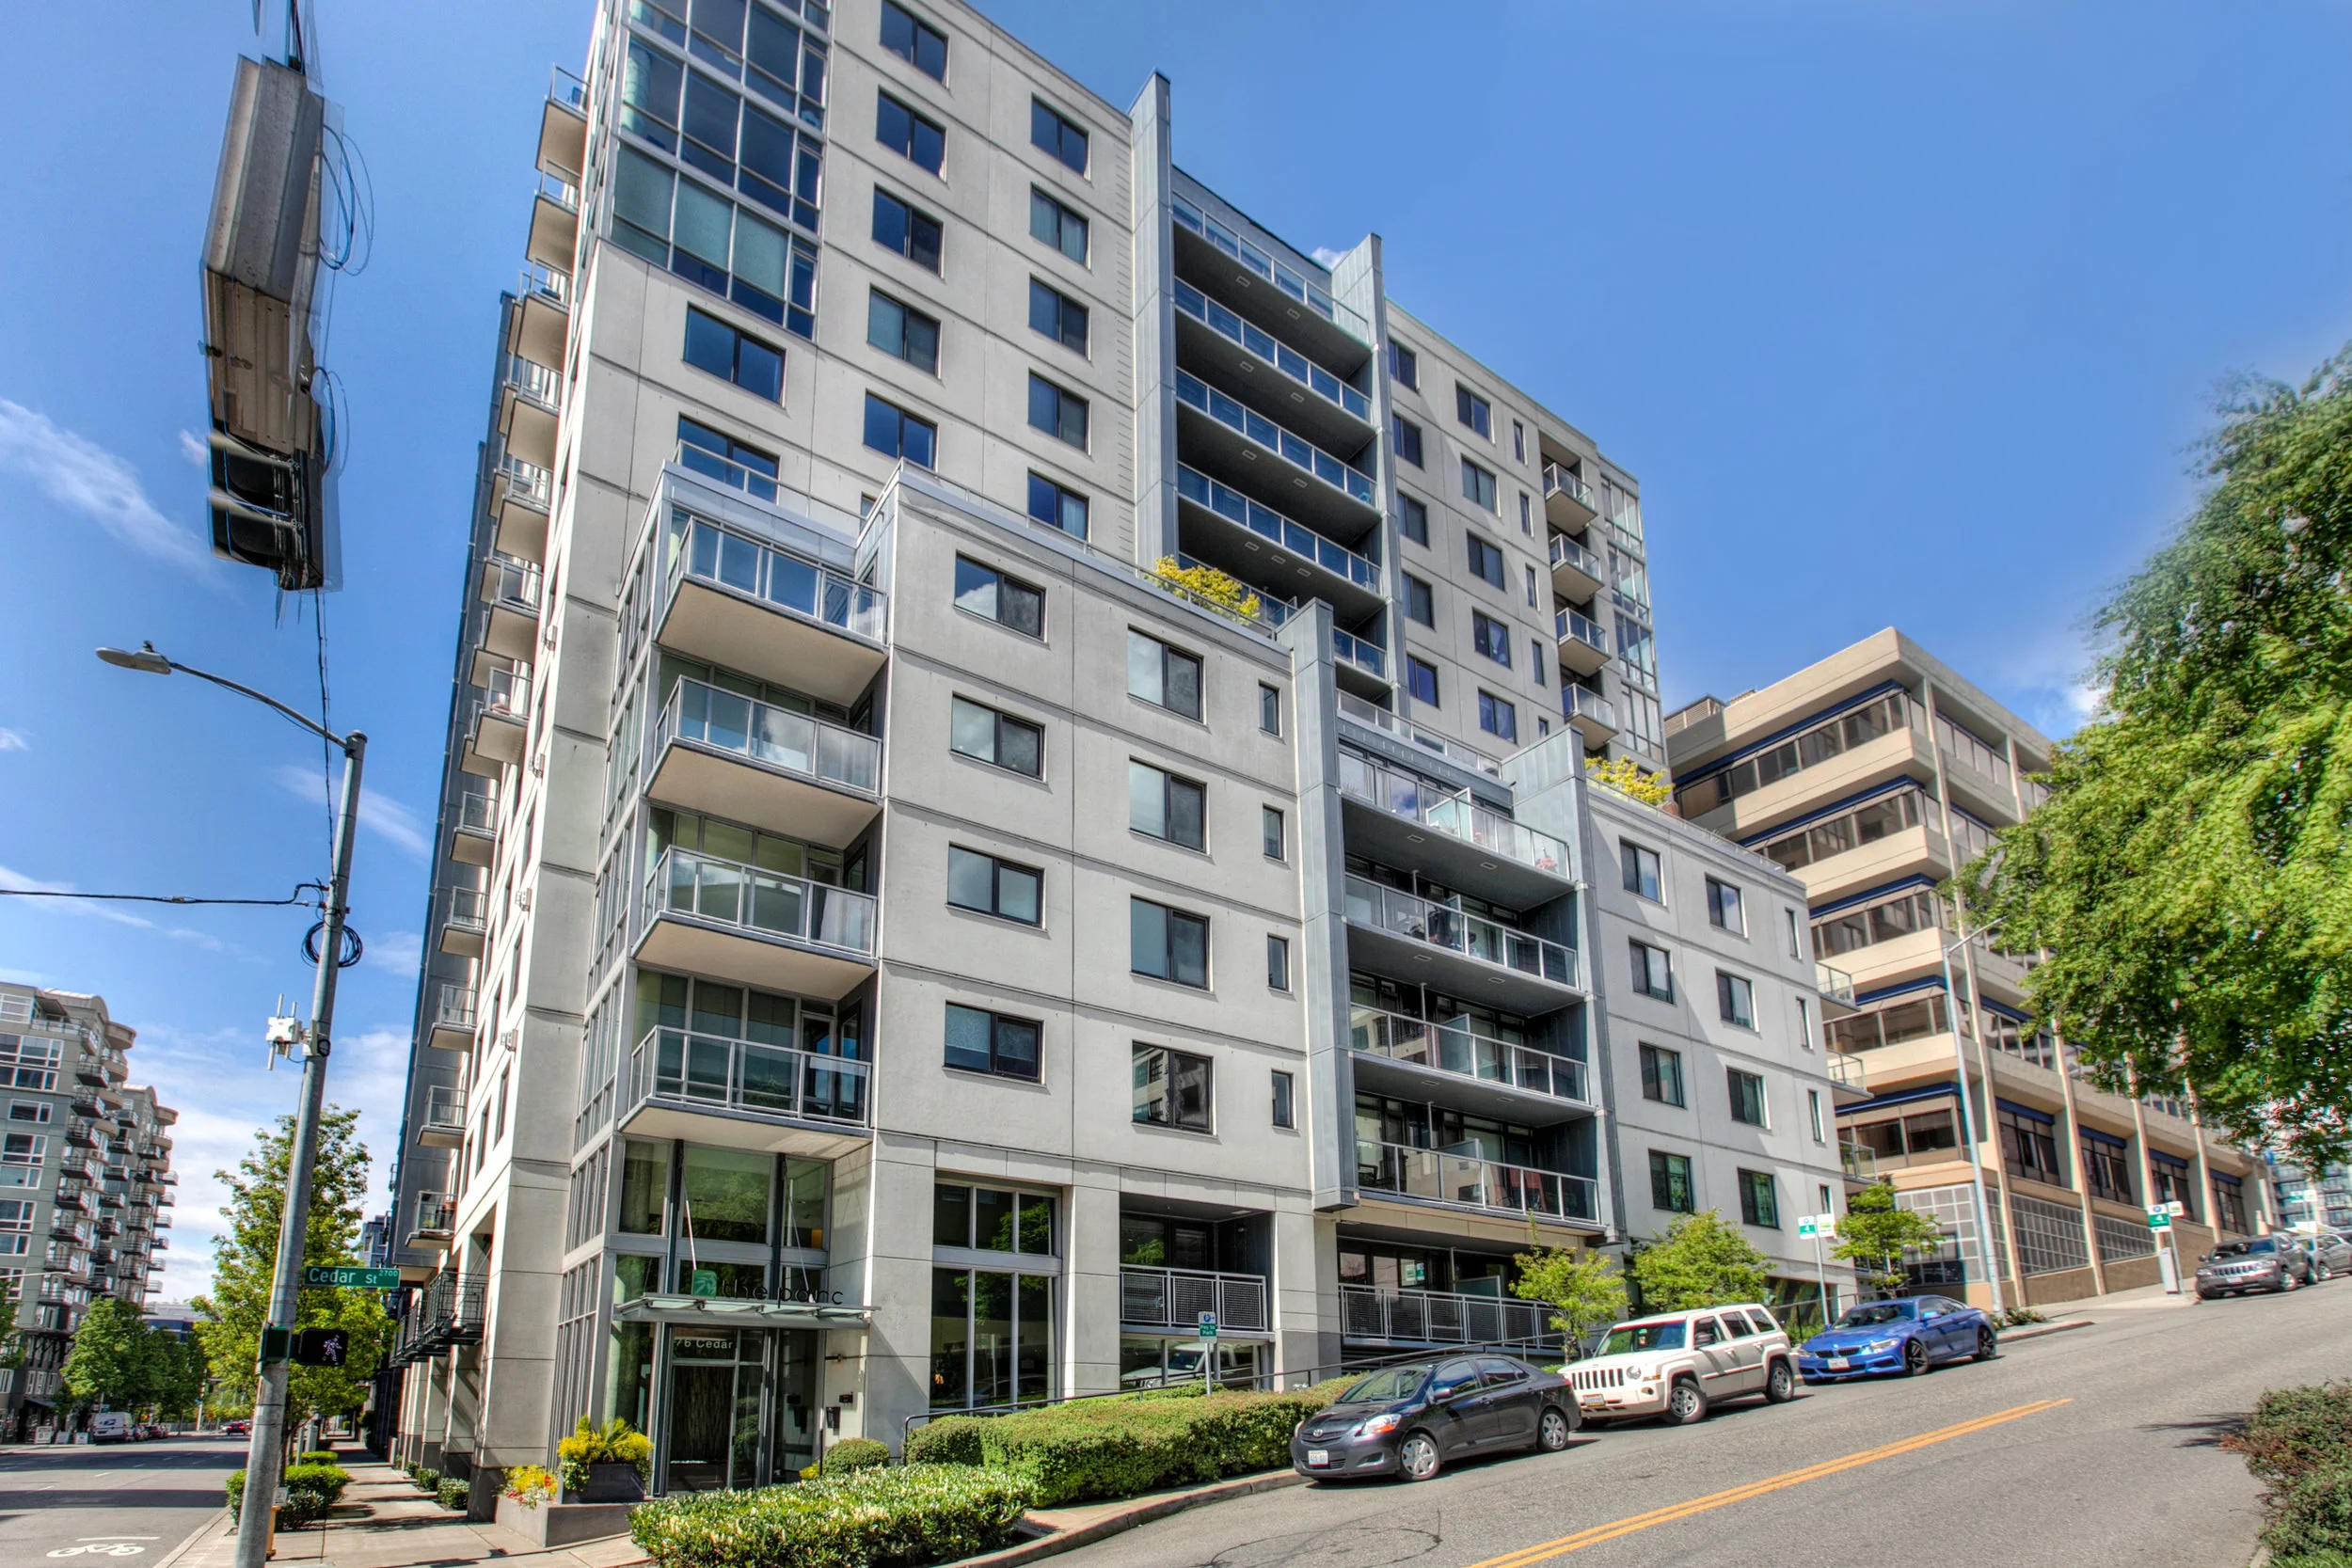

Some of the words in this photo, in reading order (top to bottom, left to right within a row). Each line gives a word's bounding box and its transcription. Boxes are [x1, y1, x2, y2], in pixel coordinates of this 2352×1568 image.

[309, 1267, 357, 1283] Cedar
[365, 1273, 377, 1284] St
[722, 1278, 769, 1300] the
[777, 1286, 844, 1308] parc
[675, 1338, 691, 1348] 76
[695, 1339, 734, 1350] Cedar
